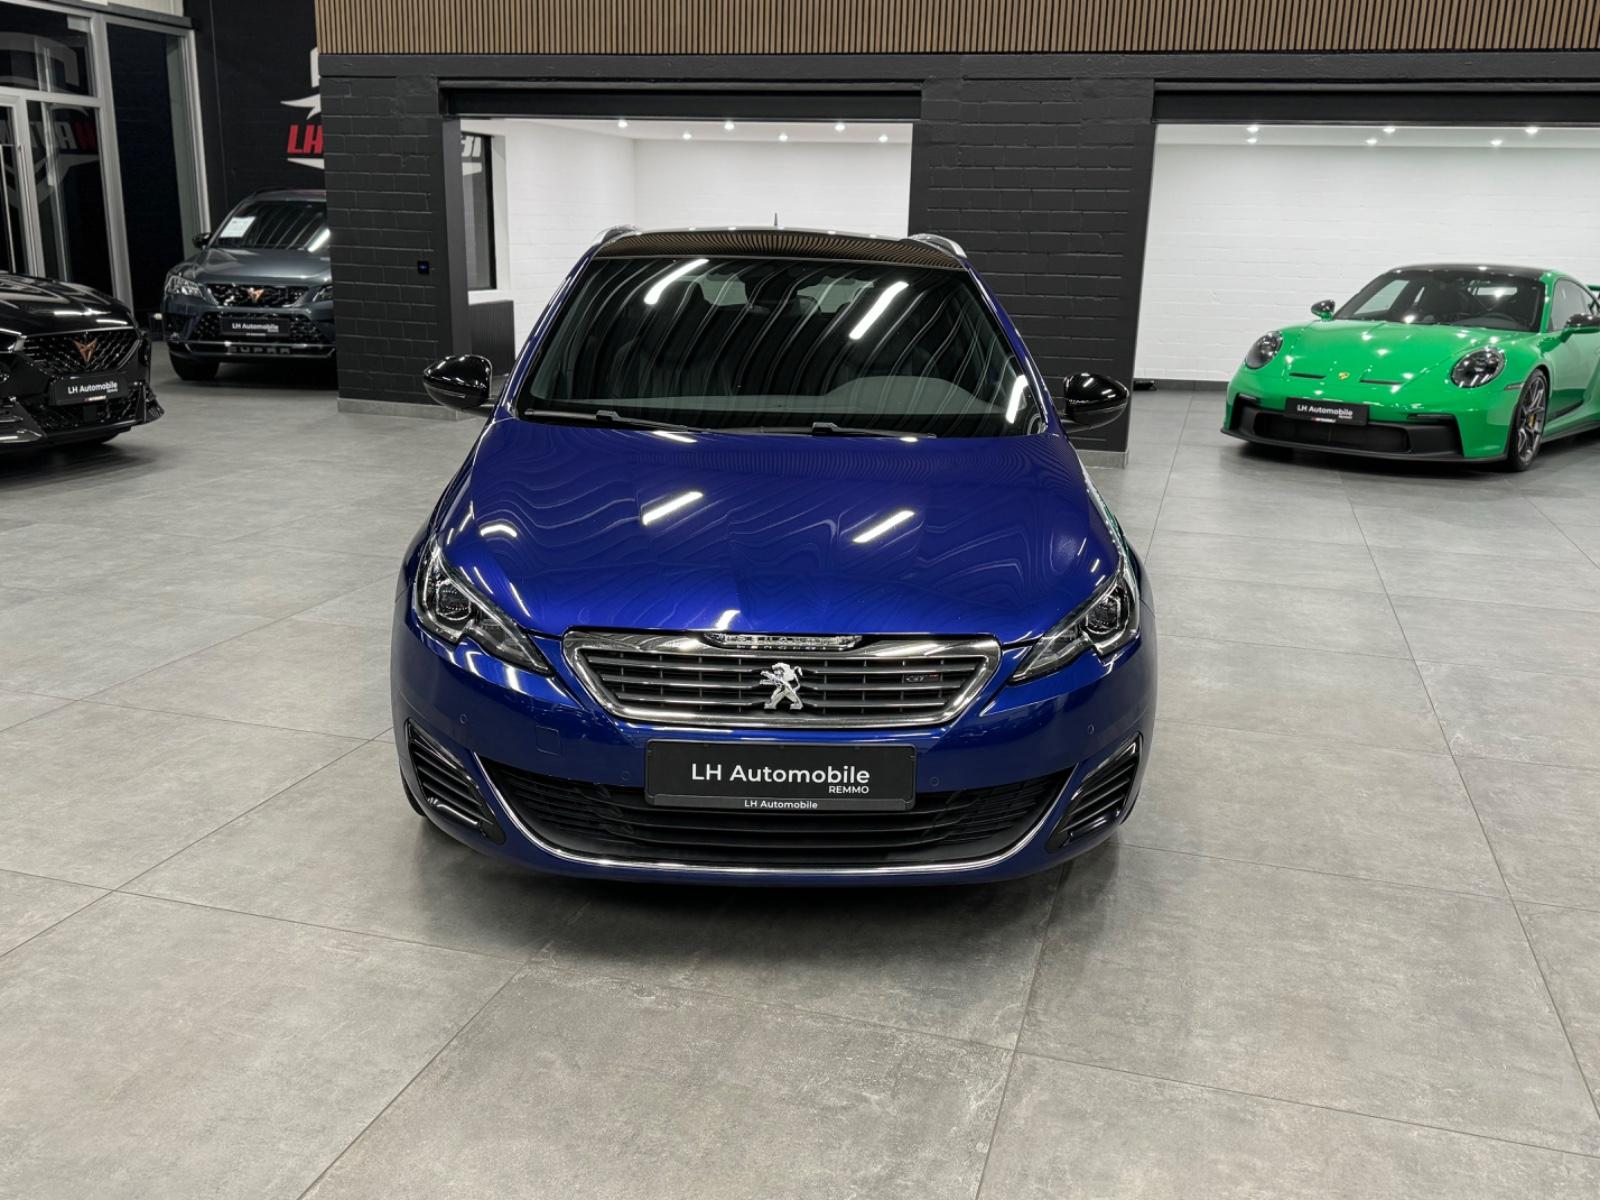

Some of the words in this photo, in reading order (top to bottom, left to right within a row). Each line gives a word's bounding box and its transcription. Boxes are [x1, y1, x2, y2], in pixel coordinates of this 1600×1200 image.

[67, 385, 79, 395] LH
[79, 381, 118, 393] Automobile
[1296, 404, 1308, 412] LH
[1308, 405, 1354, 416] Automobile
[691, 763, 722, 781] LH
[729, 765, 871, 784] Automobile
[828, 785, 870, 795] REMMO
[744, 800, 758, 808] LH
[760, 800, 818, 810] Automobile
